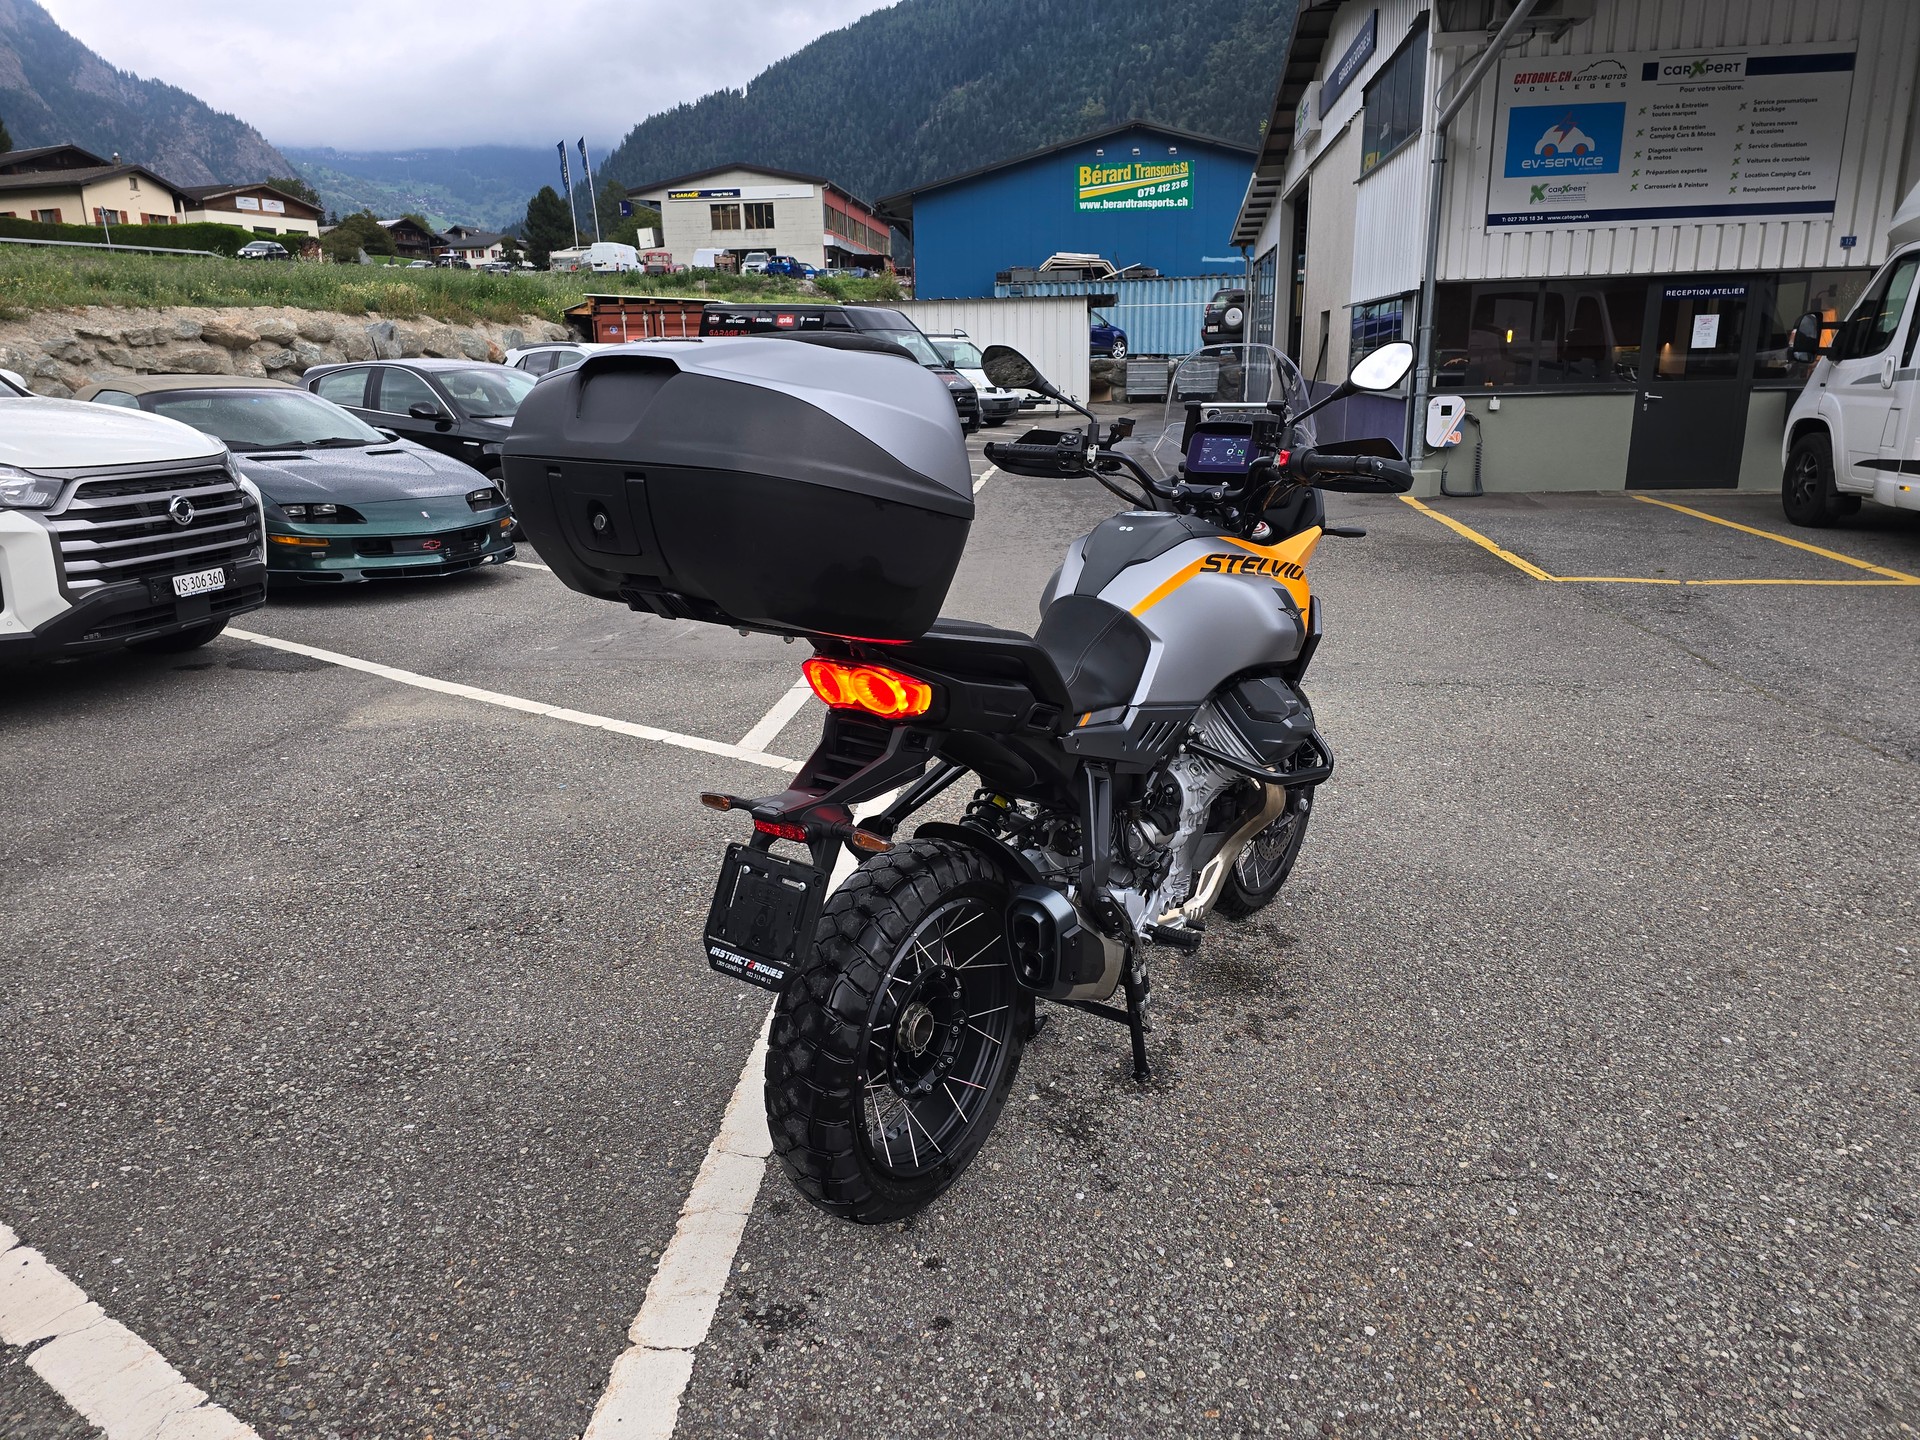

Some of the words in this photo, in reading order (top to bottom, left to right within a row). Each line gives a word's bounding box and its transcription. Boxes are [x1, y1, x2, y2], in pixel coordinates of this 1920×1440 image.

[1514, 71, 1572, 84] CATOGNE.CH
[1522, 156, 1603, 169] ev-service
[1079, 164, 1131, 186] Bérard
[1135, 163, 1179, 178] Transports
[1179, 162, 1189, 173] SA
[1138, 187, 1155, 198] 079
[1157, 184, 1170, 193] 412
[1172, 181, 1180, 190] 23
[1079, 197, 1188, 209] www.berardtransports.ch
[1200, 554, 1304, 580] STELVIO
